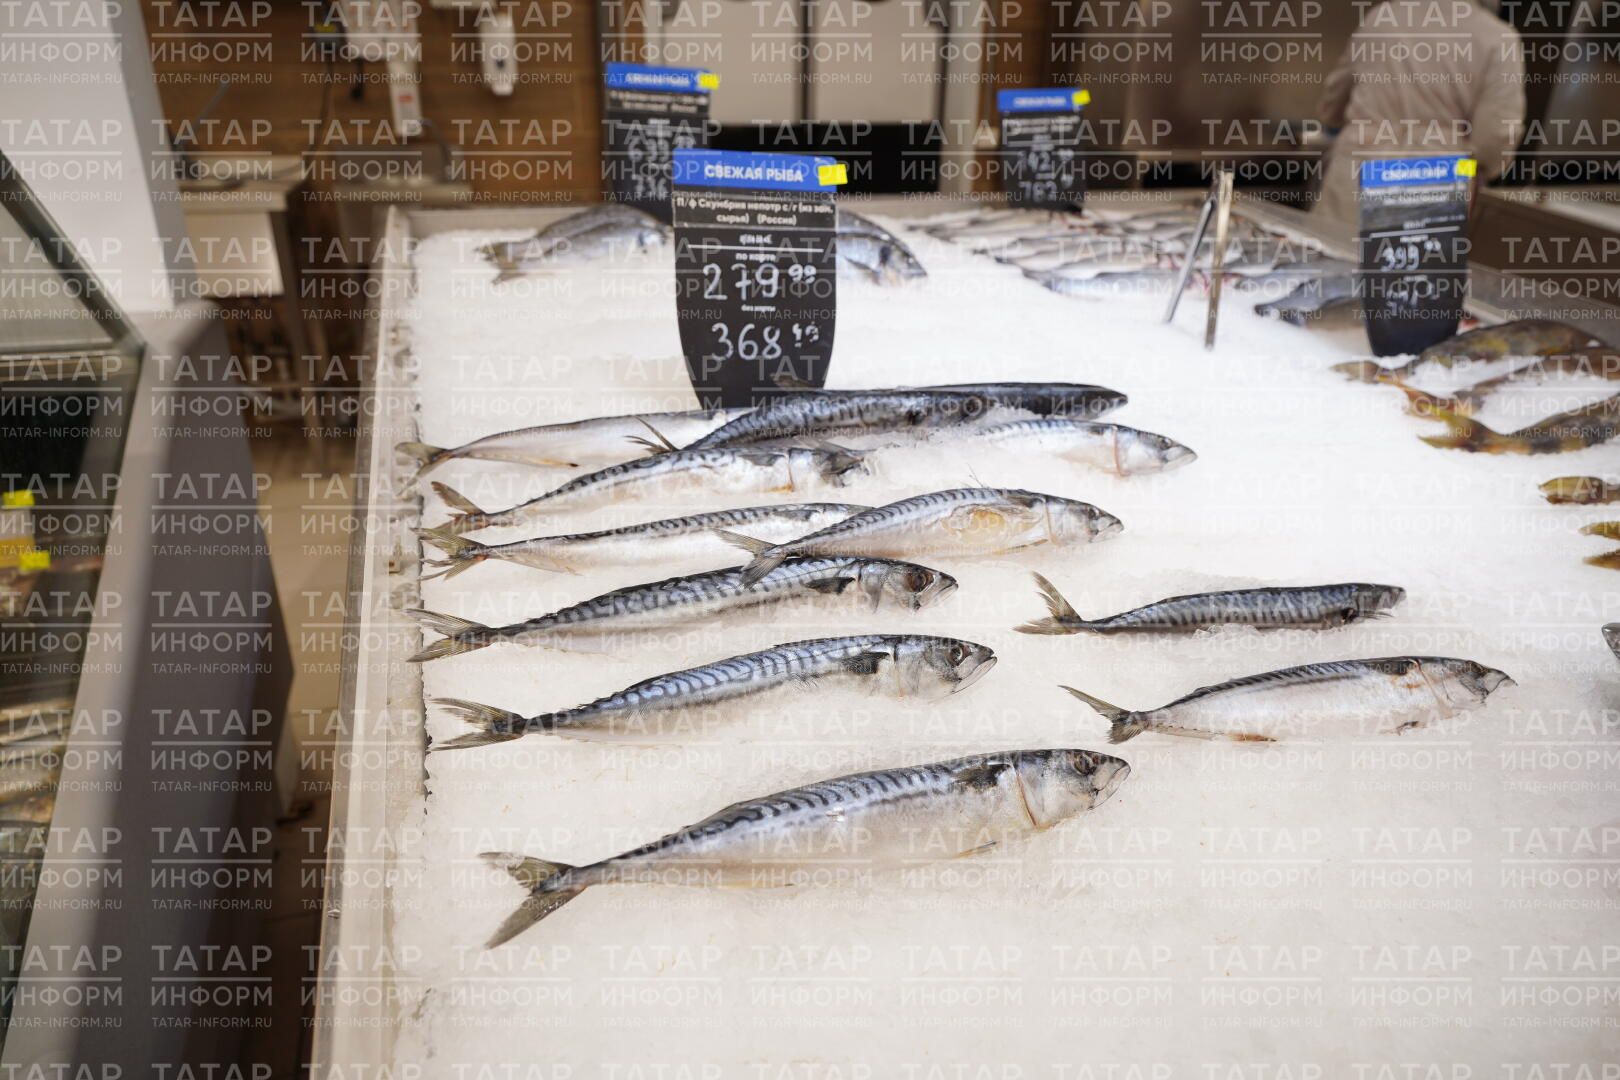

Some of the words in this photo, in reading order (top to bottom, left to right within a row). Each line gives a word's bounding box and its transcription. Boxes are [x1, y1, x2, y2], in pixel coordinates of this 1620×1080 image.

[704, 164, 763, 180] СВЕЖАЯ
[766, 168, 804, 182] РЫБА
[702, 263, 781, 301] 279
[711, 322, 783, 361] 368
